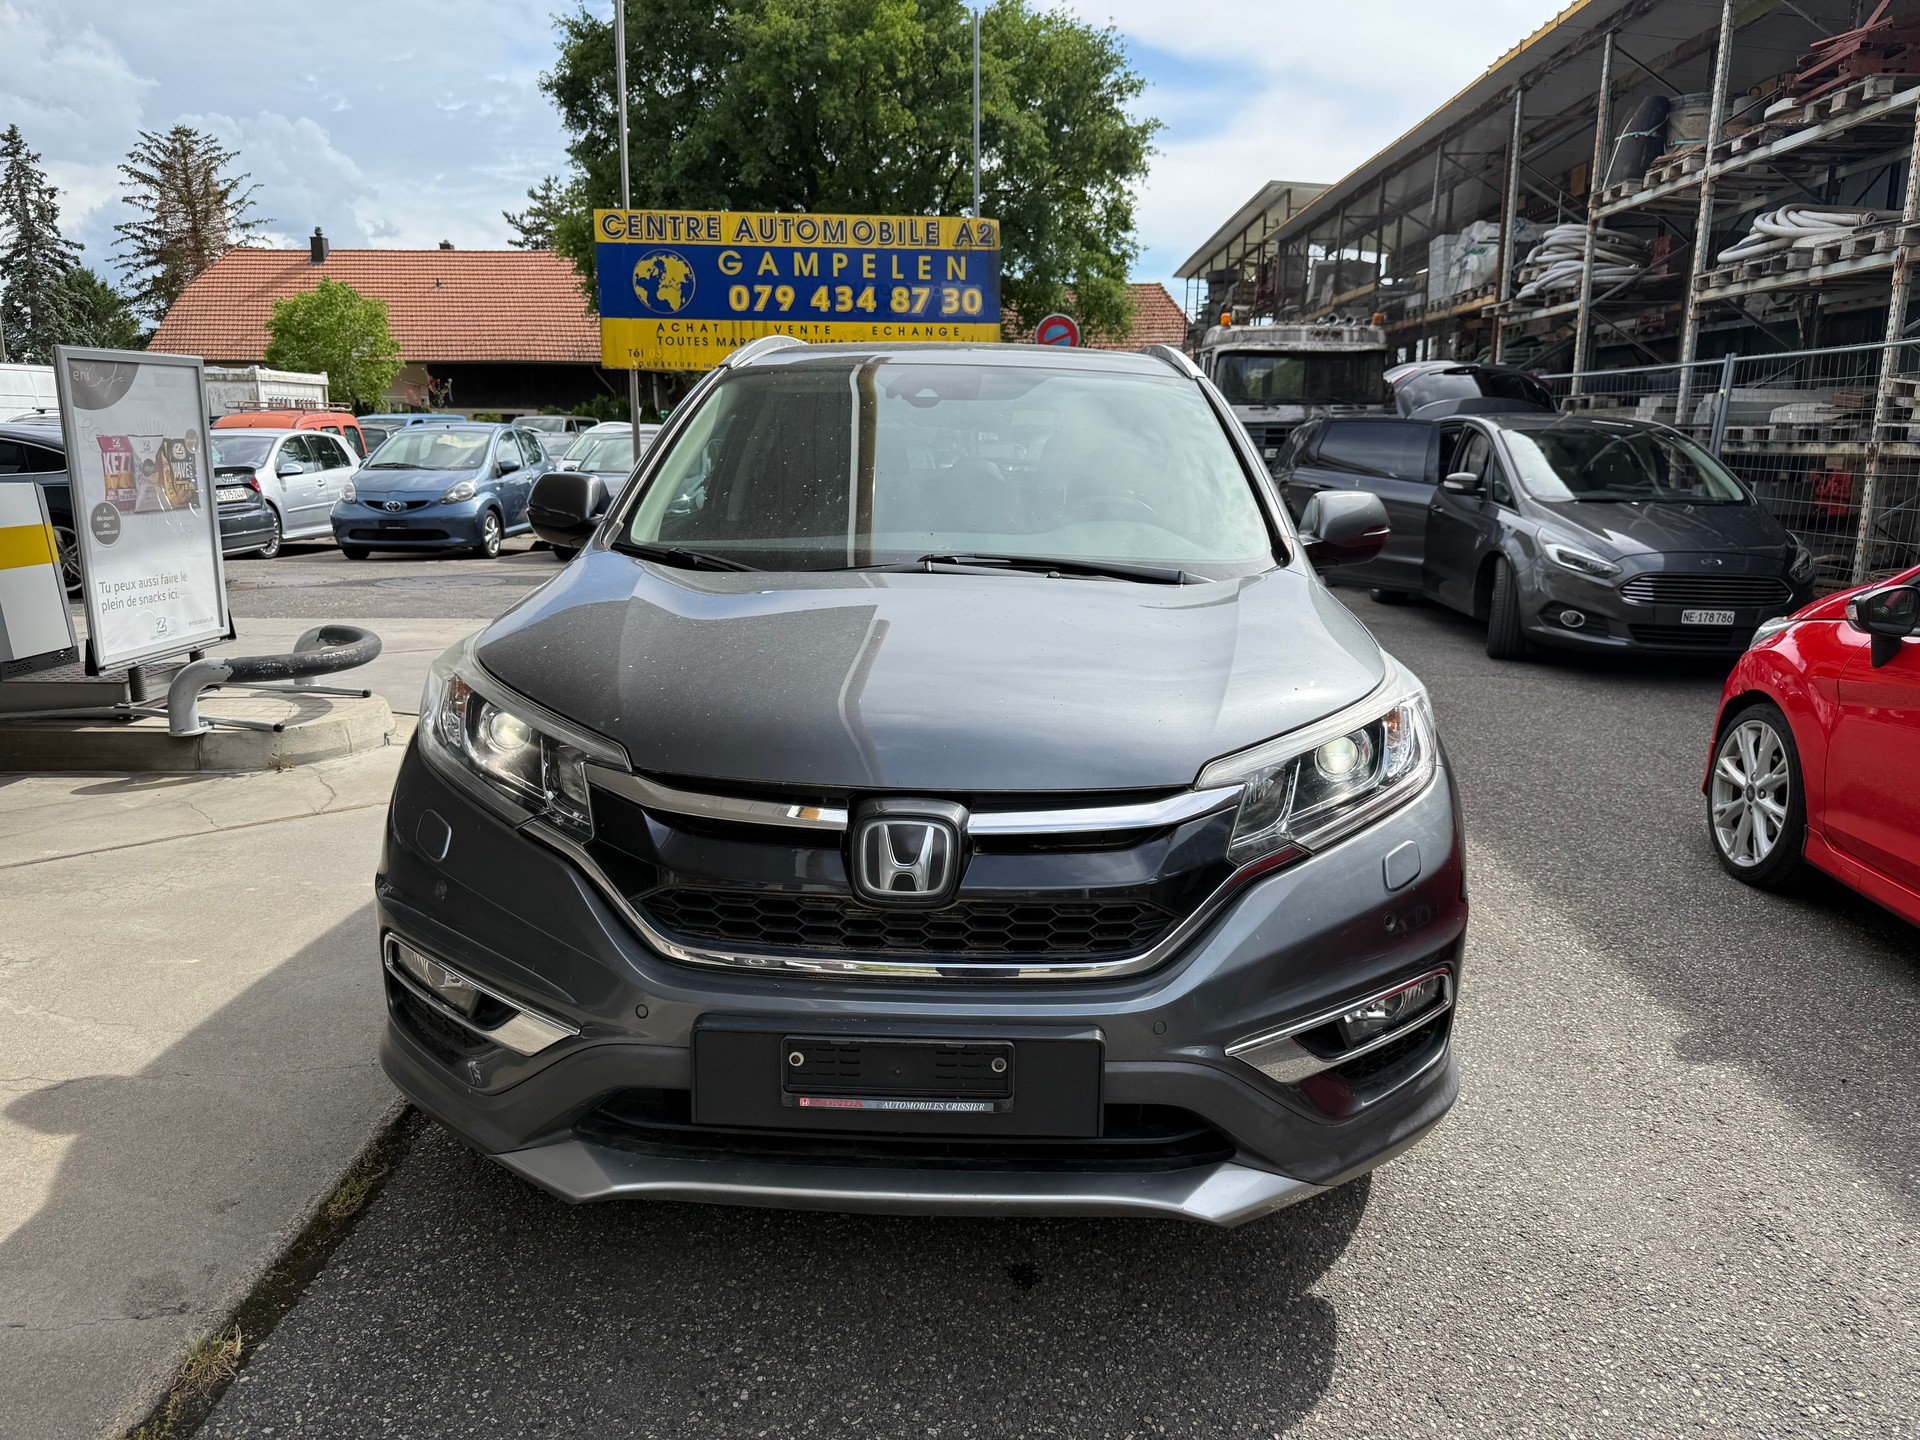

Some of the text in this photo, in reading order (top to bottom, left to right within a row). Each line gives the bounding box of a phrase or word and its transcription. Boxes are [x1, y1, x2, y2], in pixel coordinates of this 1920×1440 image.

[601, 213, 995, 247] CENTRE AUTOMOBILE A2
[718, 250, 966, 281] GAMPELEN
[729, 285, 982, 315] 079 434 87 30
[657, 323, 960, 336] ACHAT VENTE ECHANGE
[658, 336, 709, 346] TOUTES
[628, 348, 644, 358] Tél
[73, 367, 90, 381] eni
[99, 571, 188, 595] Tu peux aussi faire le
[101, 587, 180, 614] plein de snacks ici.
[812, 1099, 864, 1108] HONDA
[882, 1101, 944, 1110] AUTOMOBILES
[945, 1102, 985, 1111] CRISSIER
